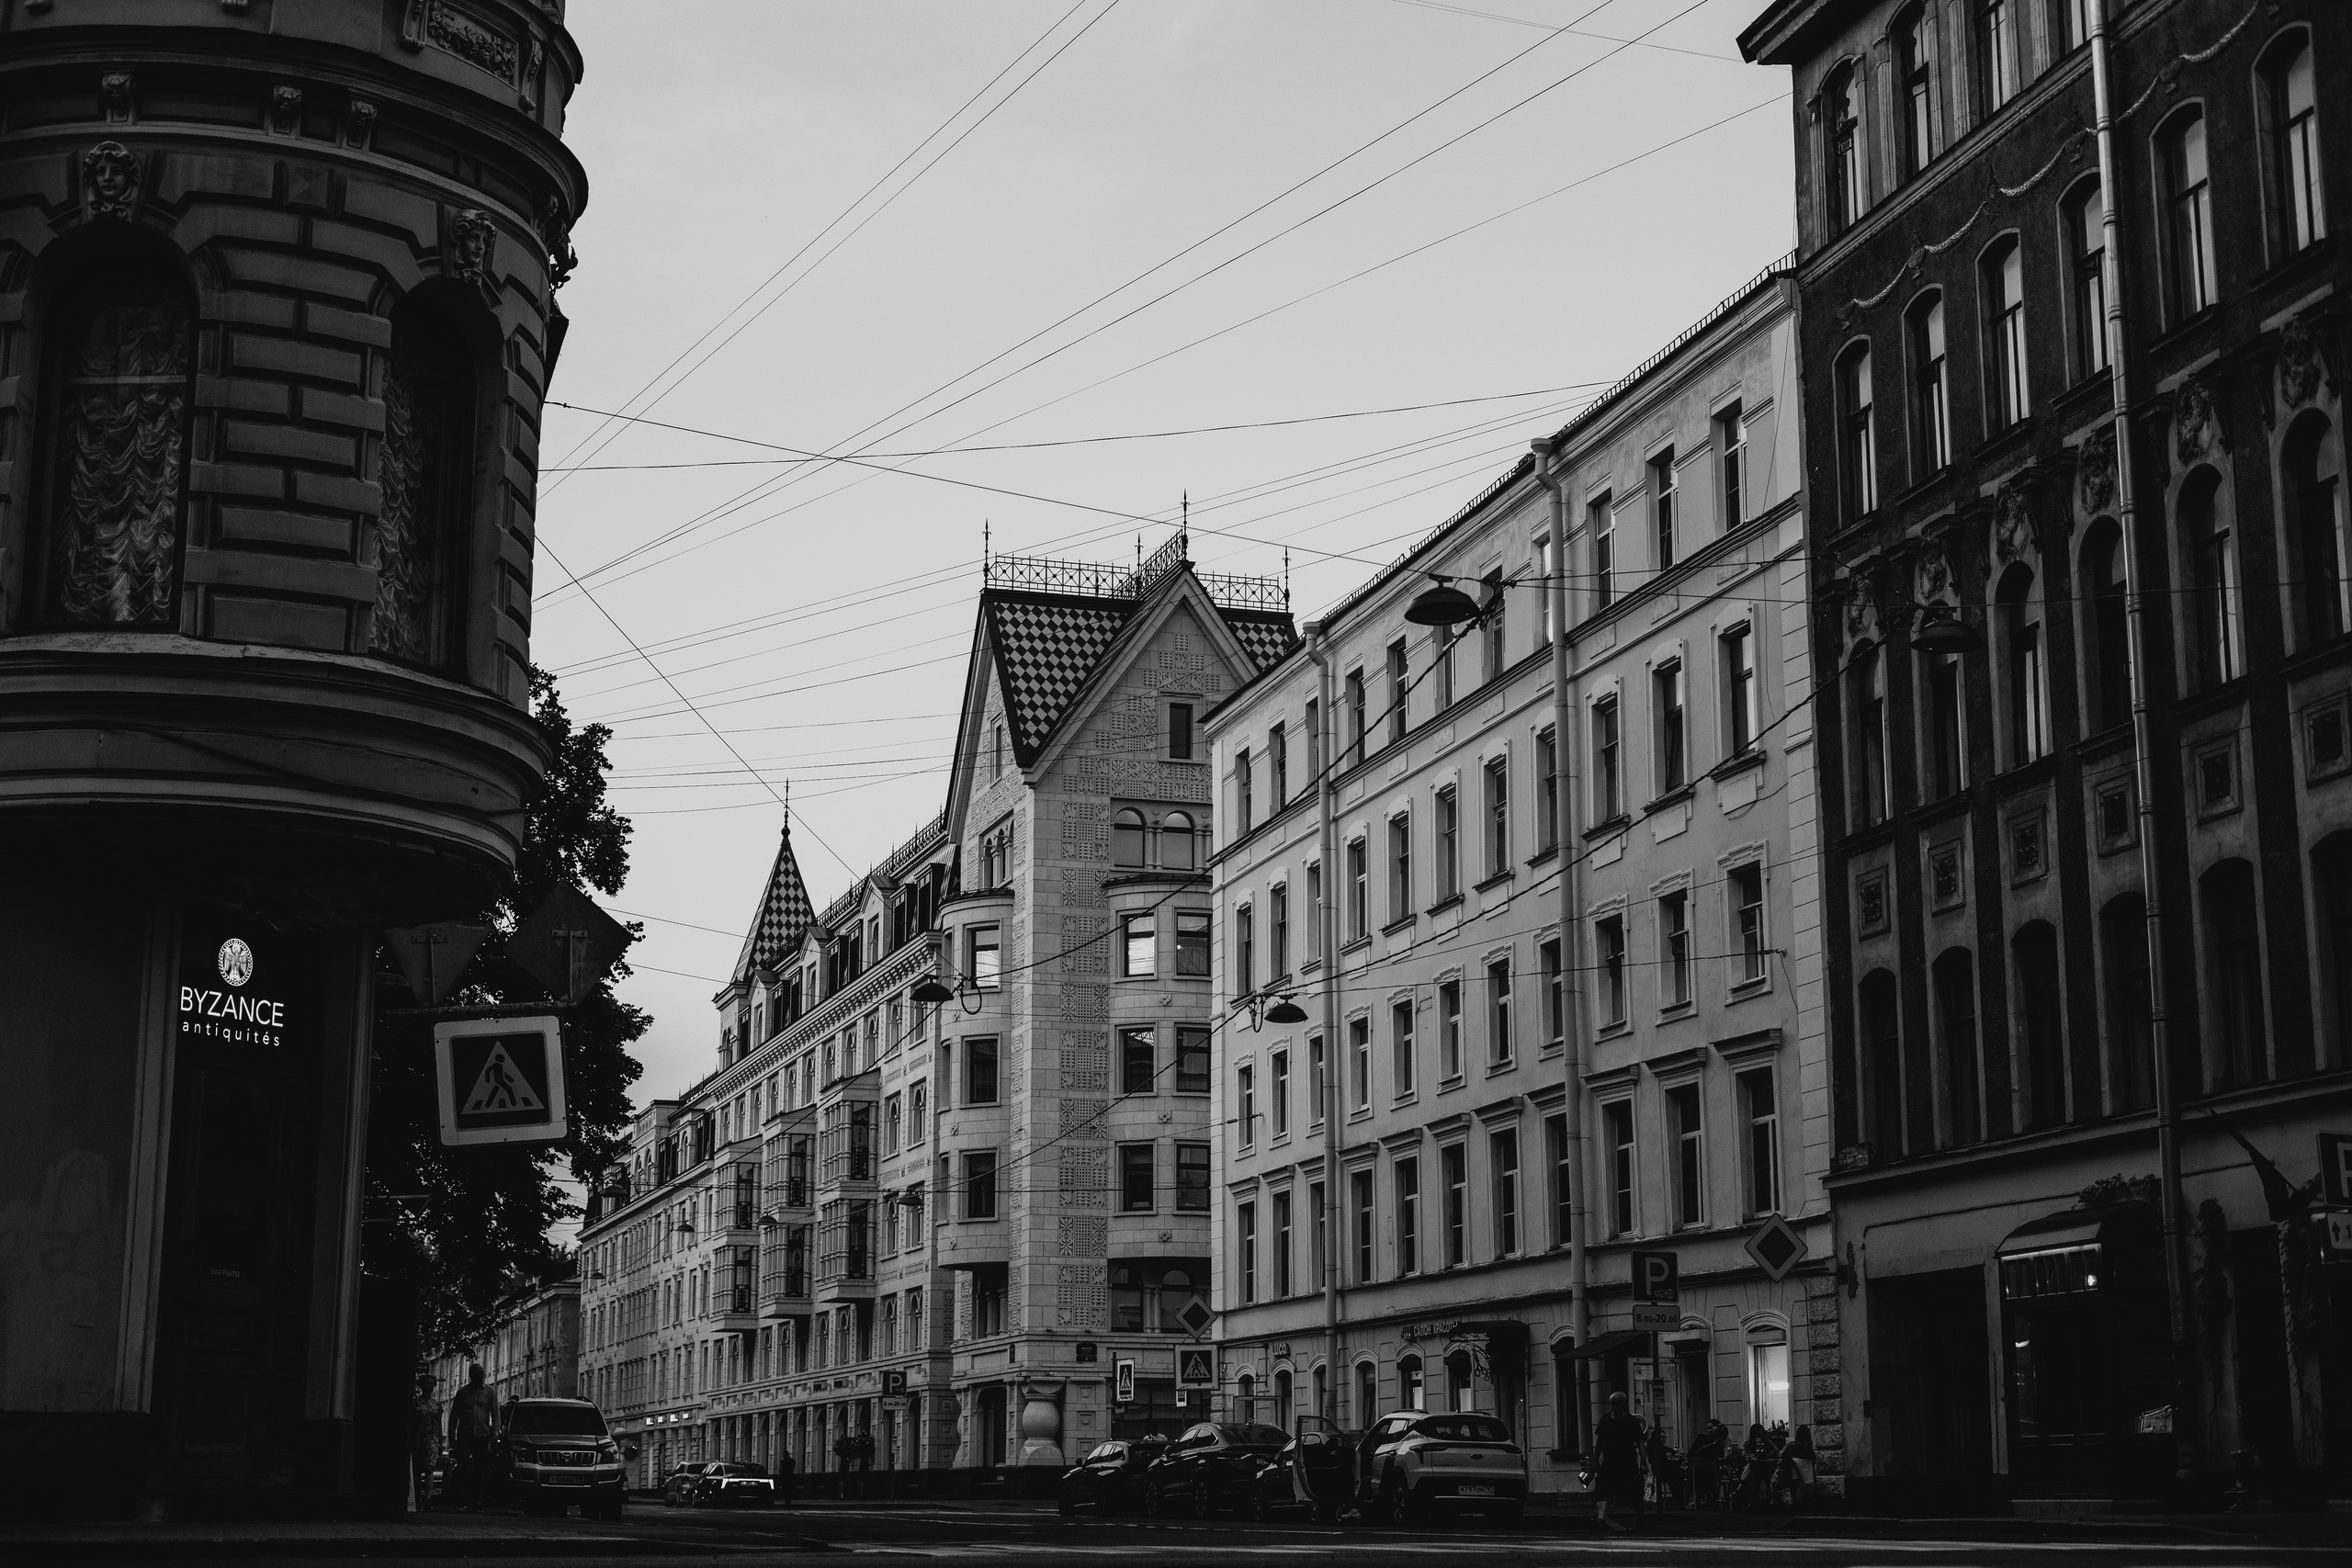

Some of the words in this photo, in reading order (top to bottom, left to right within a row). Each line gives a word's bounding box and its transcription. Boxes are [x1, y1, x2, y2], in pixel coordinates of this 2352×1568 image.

[181, 986, 284, 1027] BYZANCE
[182, 1021, 280, 1046] antiquités
[210, 1268, 241, 1278] ЗАКРЫТО
[1645, 1257, 1669, 1296] P
[1636, 1314, 1678, 1324] 8.00-20.00
[888, 1373, 903, 1393] P
